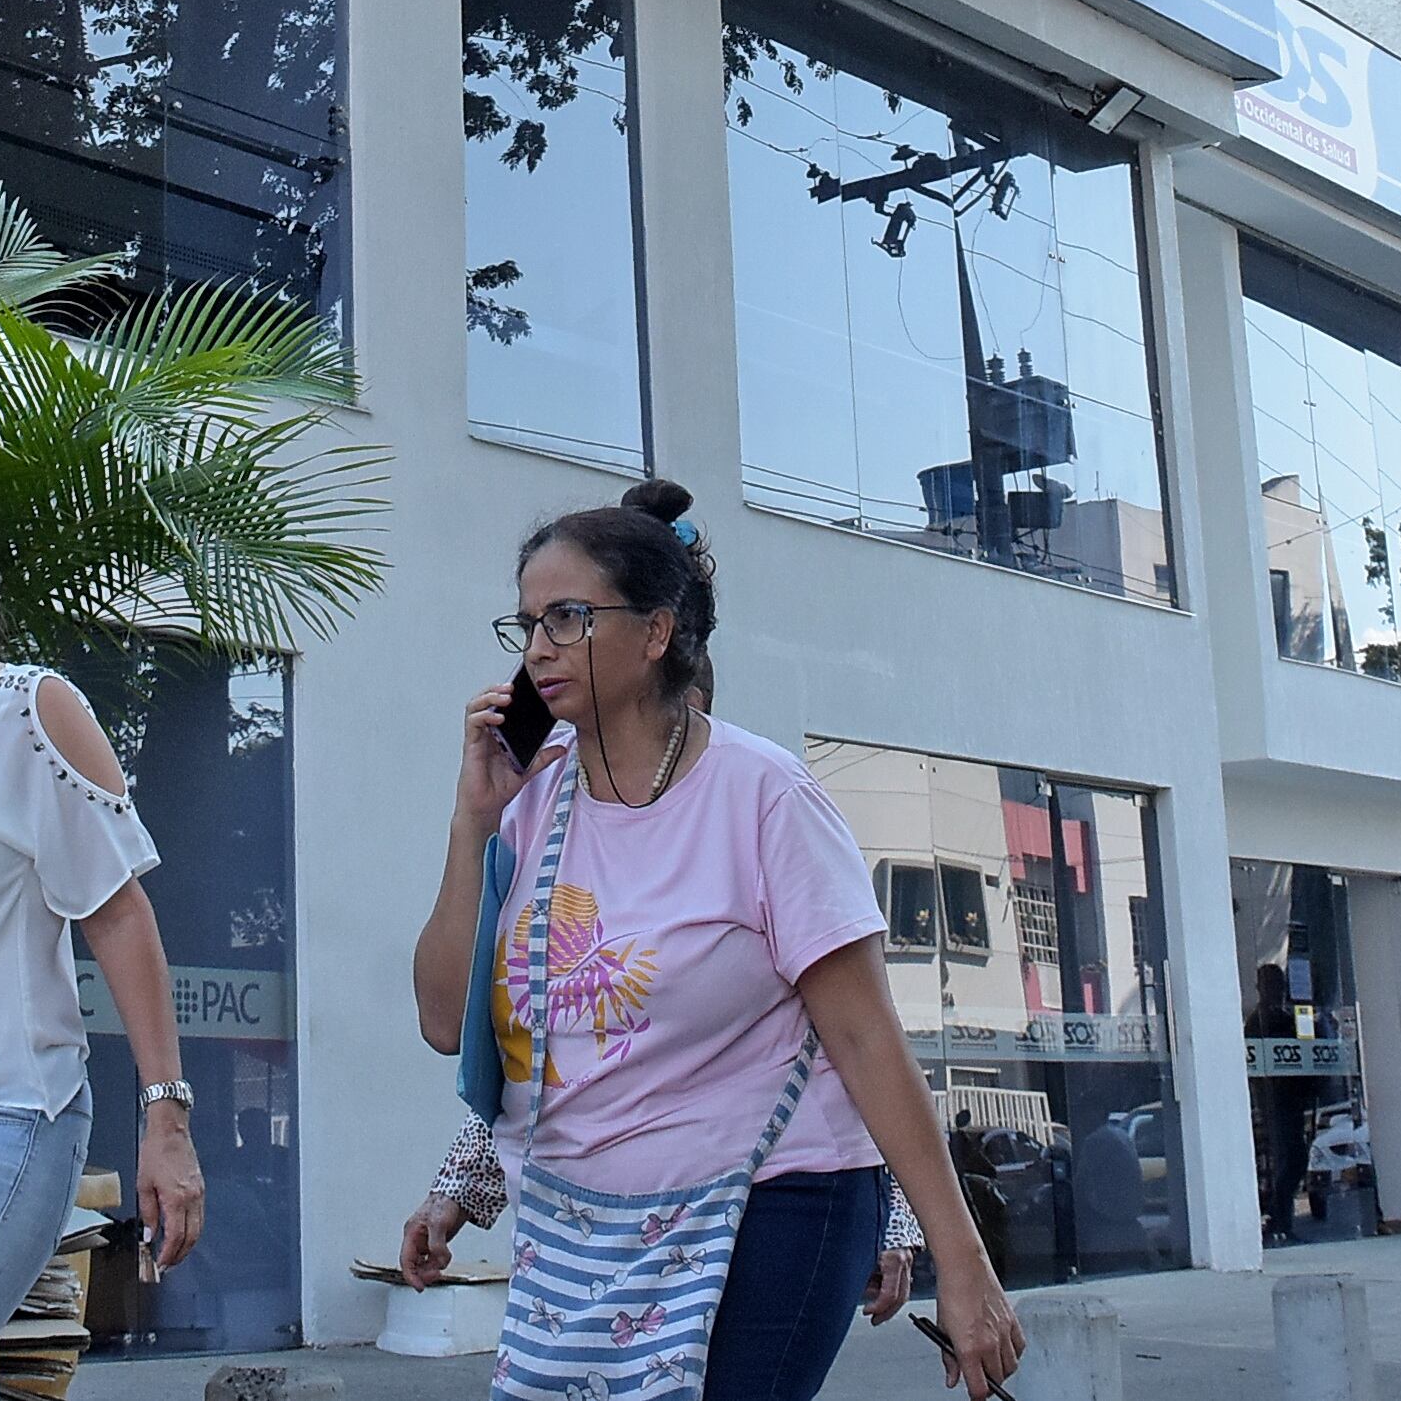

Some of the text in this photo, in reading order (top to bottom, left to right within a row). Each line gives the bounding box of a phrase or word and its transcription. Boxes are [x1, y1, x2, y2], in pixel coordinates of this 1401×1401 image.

[1244, 97, 1303, 143] Occidental
[1306, 131, 1320, 148] de
[1322, 138, 1351, 167] Salud
[202, 980, 261, 1025] PAC
[1273, 1045, 1303, 1063] SOS
